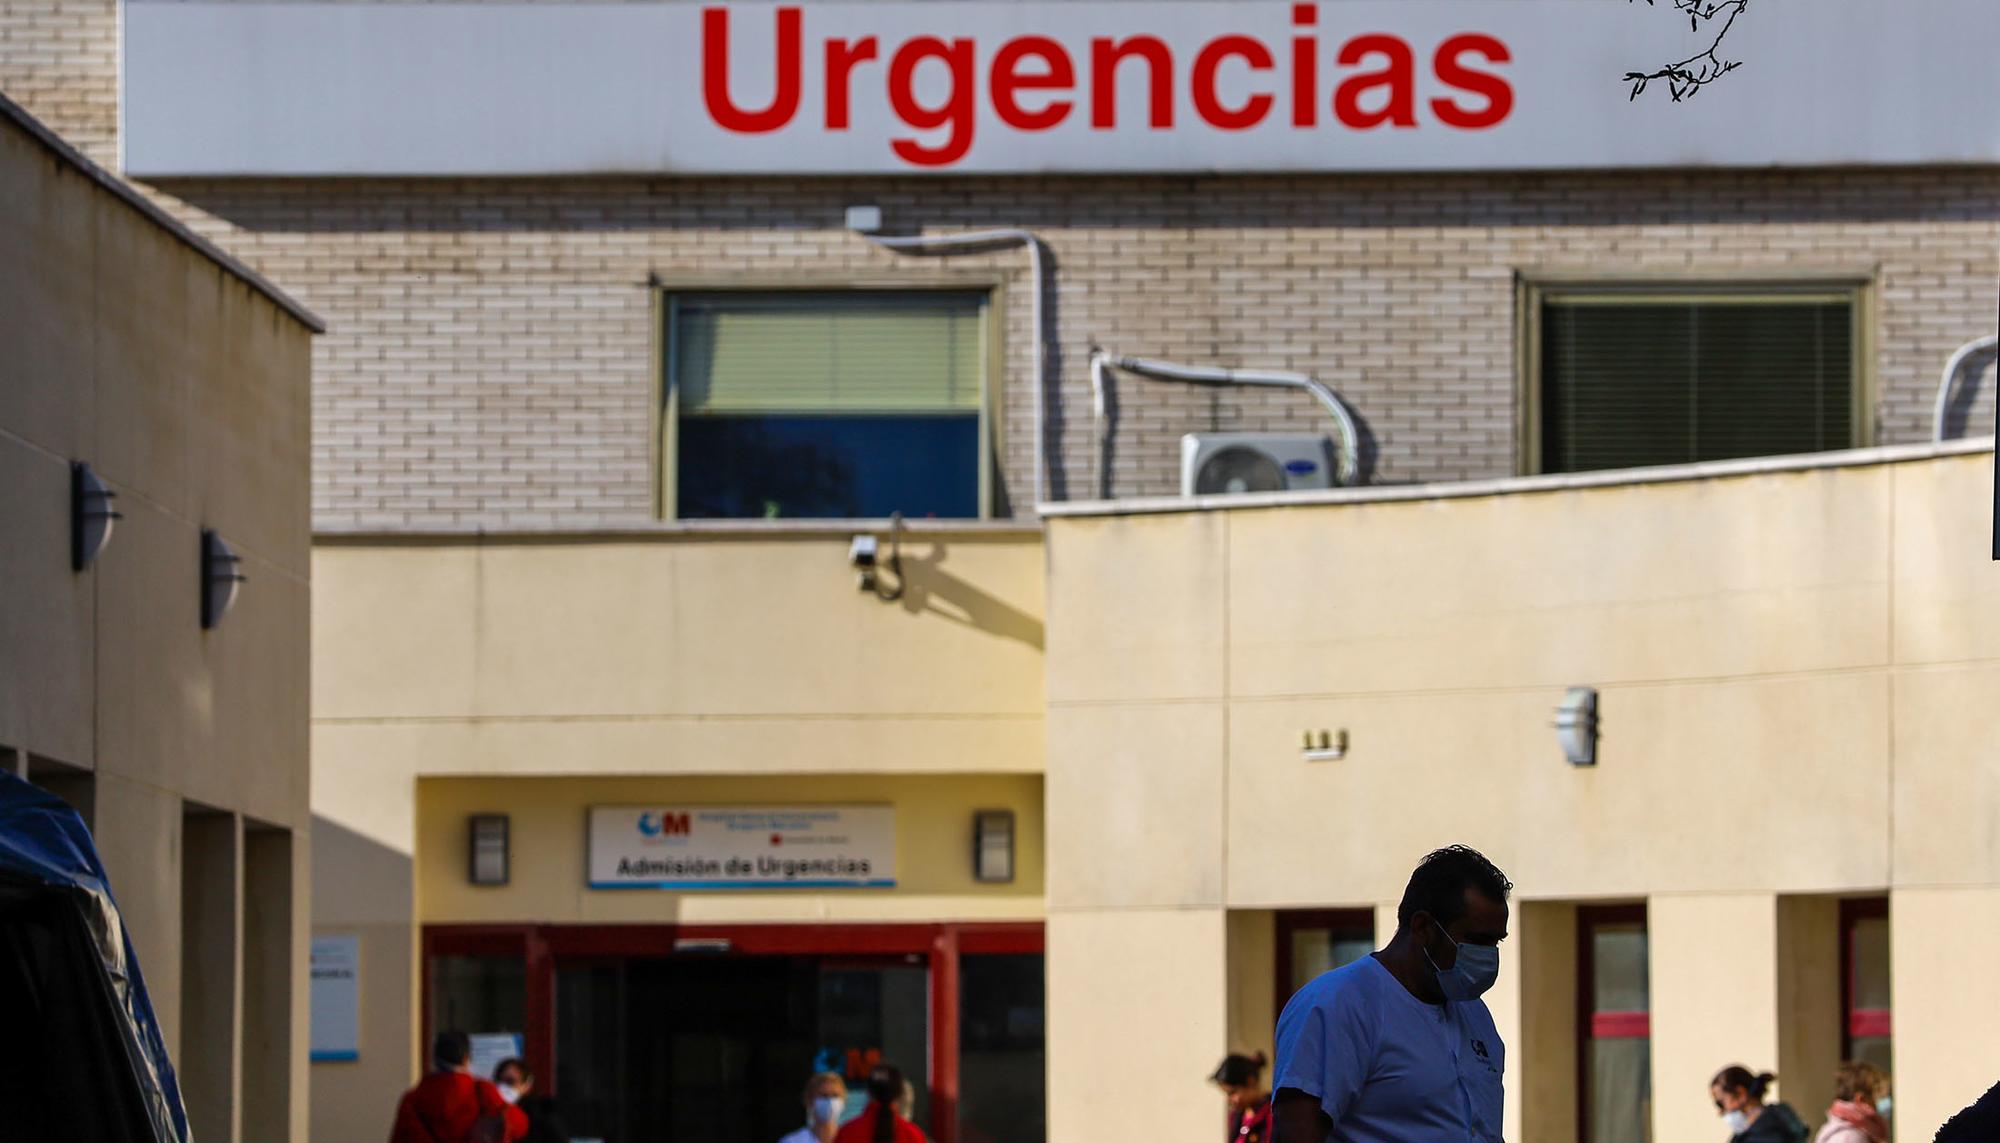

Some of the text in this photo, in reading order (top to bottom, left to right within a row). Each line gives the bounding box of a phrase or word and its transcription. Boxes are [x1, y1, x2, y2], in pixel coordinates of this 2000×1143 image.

[702, 3, 1515, 166] Urgencias
[617, 856, 872, 879] Admisión de Urgencias
